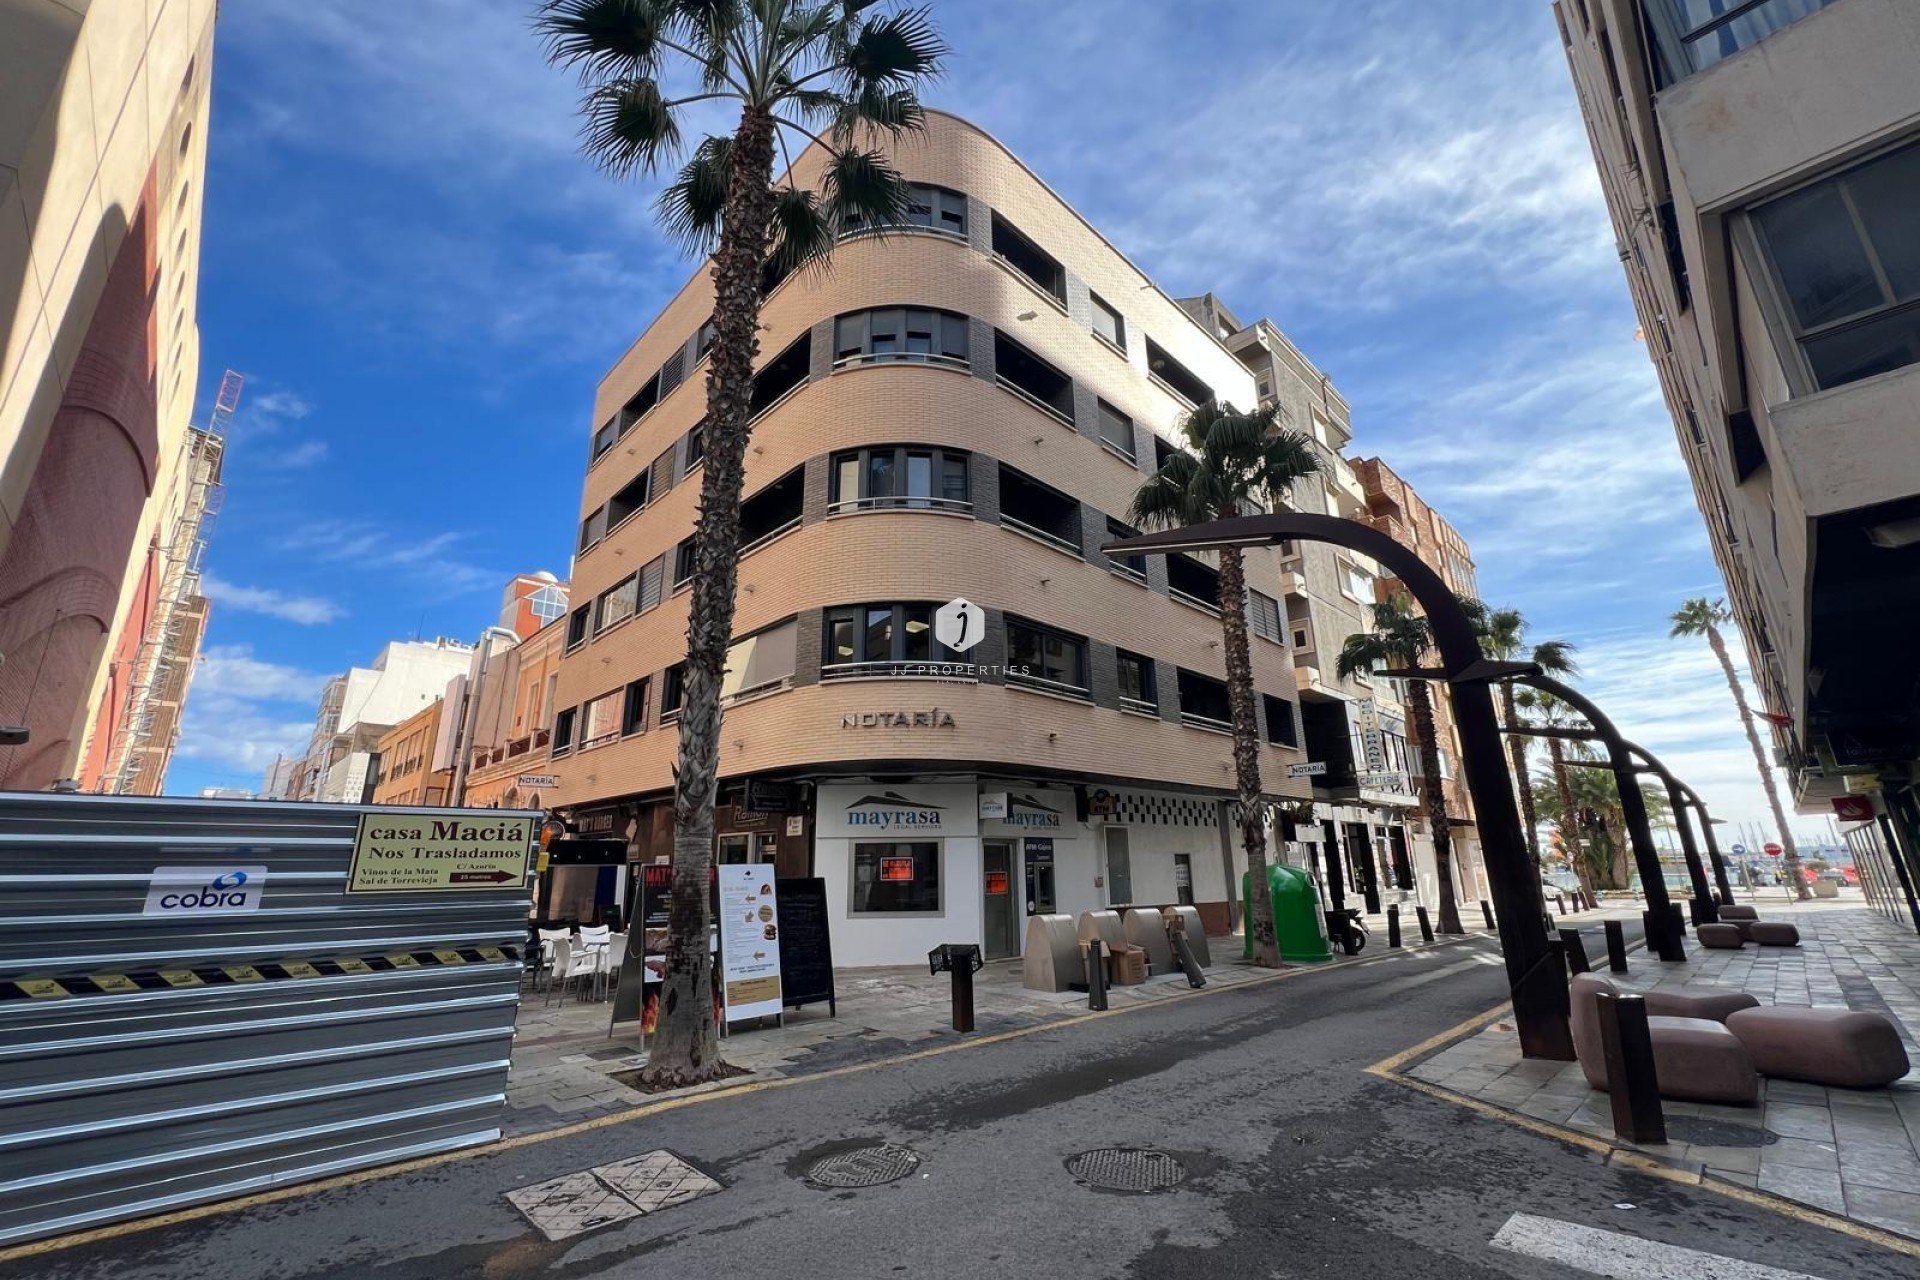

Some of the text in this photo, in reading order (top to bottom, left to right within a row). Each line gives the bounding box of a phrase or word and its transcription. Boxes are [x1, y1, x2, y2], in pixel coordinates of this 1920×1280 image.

[841, 707, 956, 728] NOTARÍA
[847, 810, 941, 830] mayrasa
[370, 820, 523, 841] casa Maciá
[368, 847, 521, 859] Nos Trasladamos
[359, 877, 375, 885] Sal
[391, 876, 438, 885] Torrevieja
[362, 868, 388, 876] Vinos
[160, 886, 247, 909] cobra
